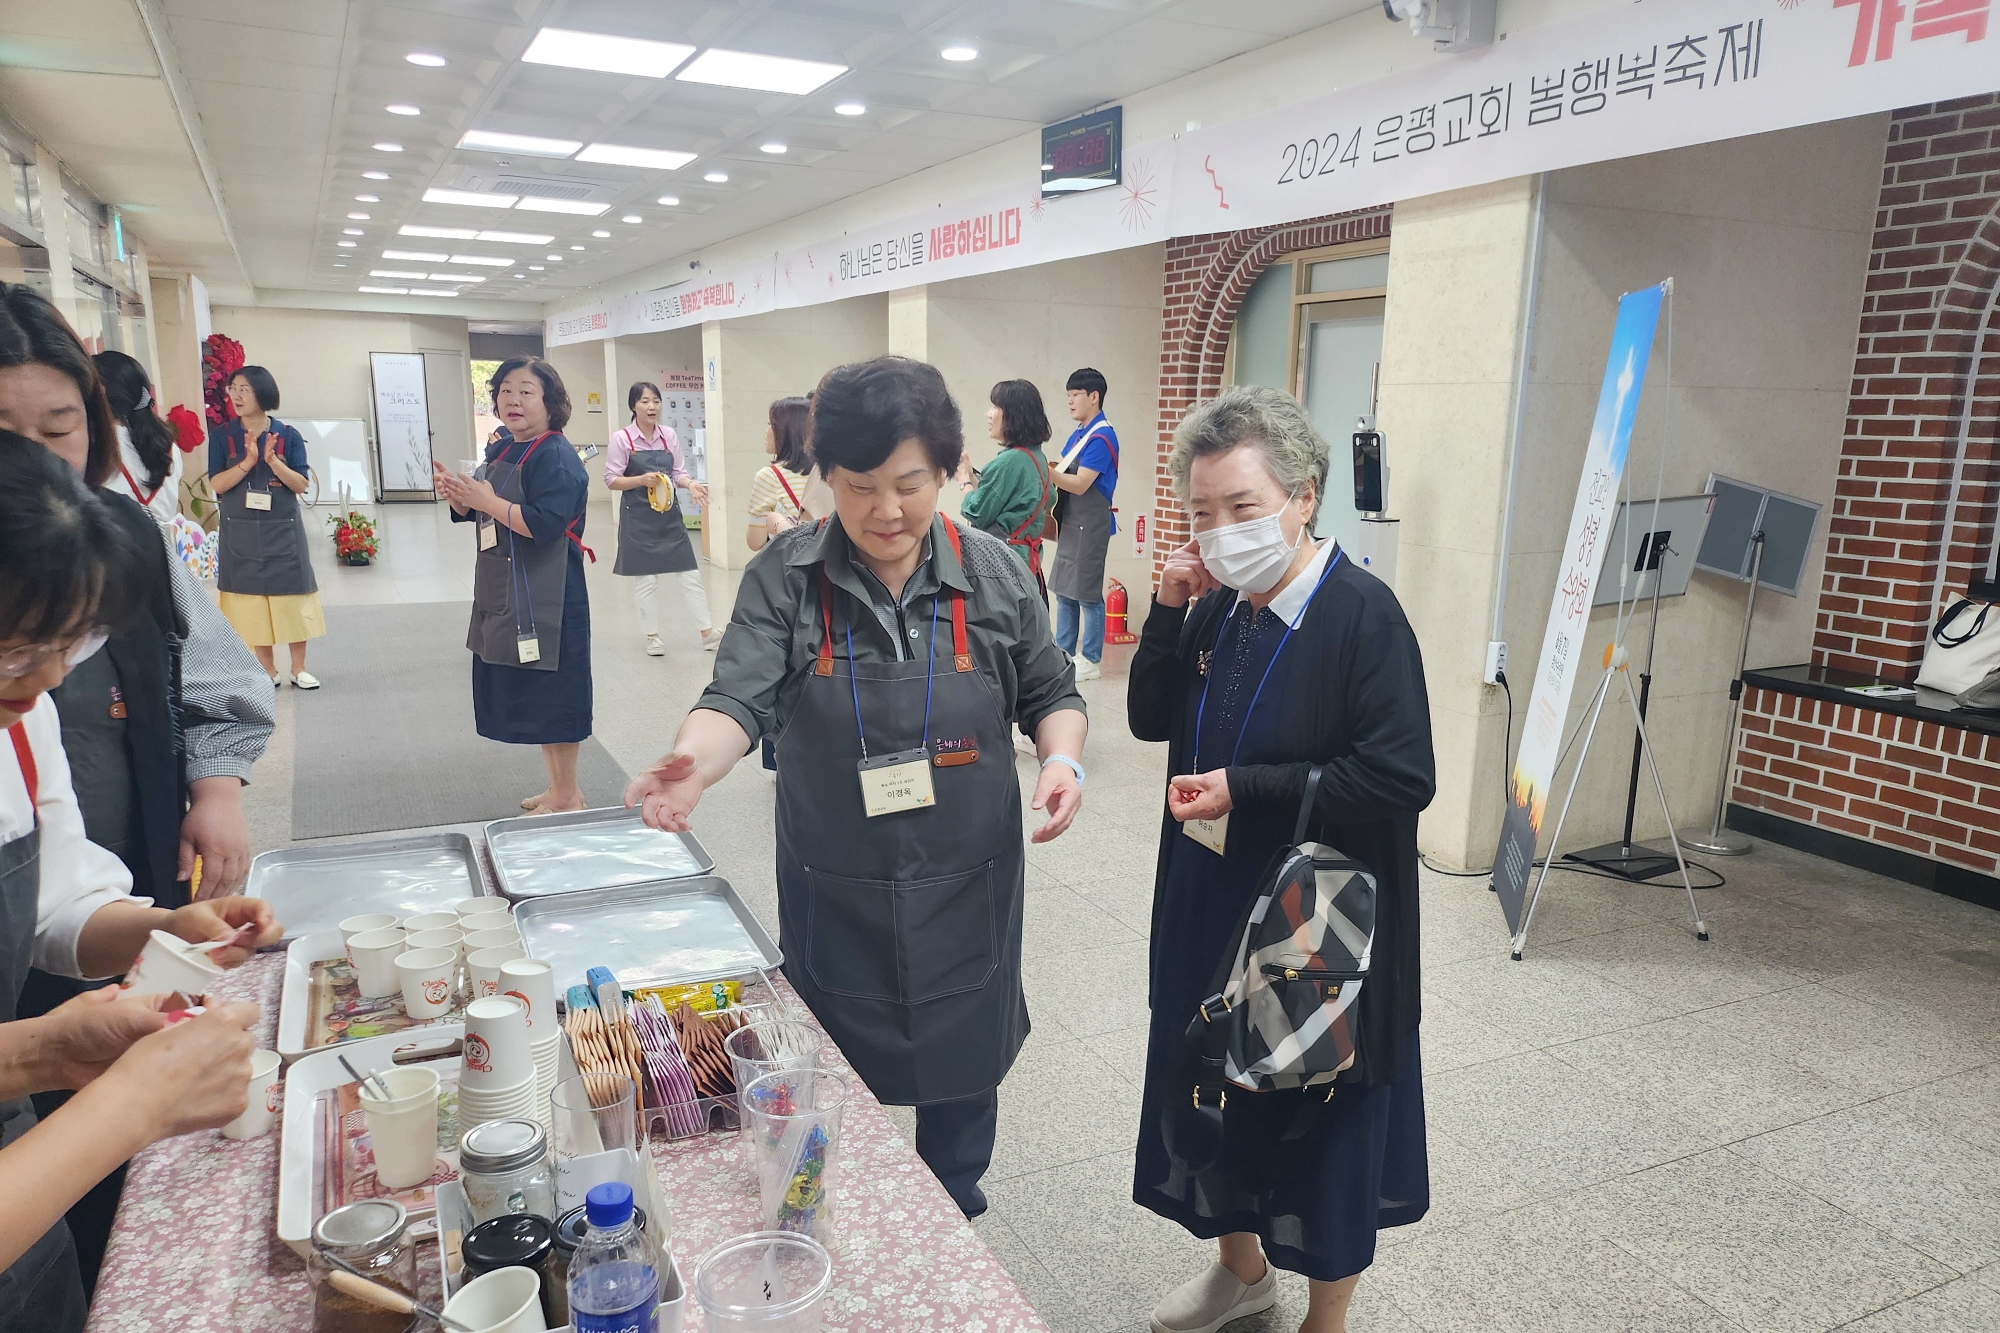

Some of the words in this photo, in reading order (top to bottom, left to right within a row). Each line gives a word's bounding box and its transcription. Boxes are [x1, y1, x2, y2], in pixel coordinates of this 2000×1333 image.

[1277, 126, 1362, 185] 2024
[1373, 82, 1512, 163] 은평교회
[1528, 18, 1764, 126] 봄행복축제
[839, 243, 883, 281] 하나님은
[887, 232, 924, 271] 당신을
[928, 207, 1022, 262] 사랑하십니다
[663, 296, 681, 318] 당신을
[680, 289, 702, 315] 환영하고
[703, 281, 735, 307] 축복합니다
[1579, 513, 1601, 567] 성령
[1561, 566, 1590, 629] 수양회
[935, 738, 961, 751] 은혜의
[887, 787, 912, 798] 이경옥
[421, 976, 446, 987] Classic
